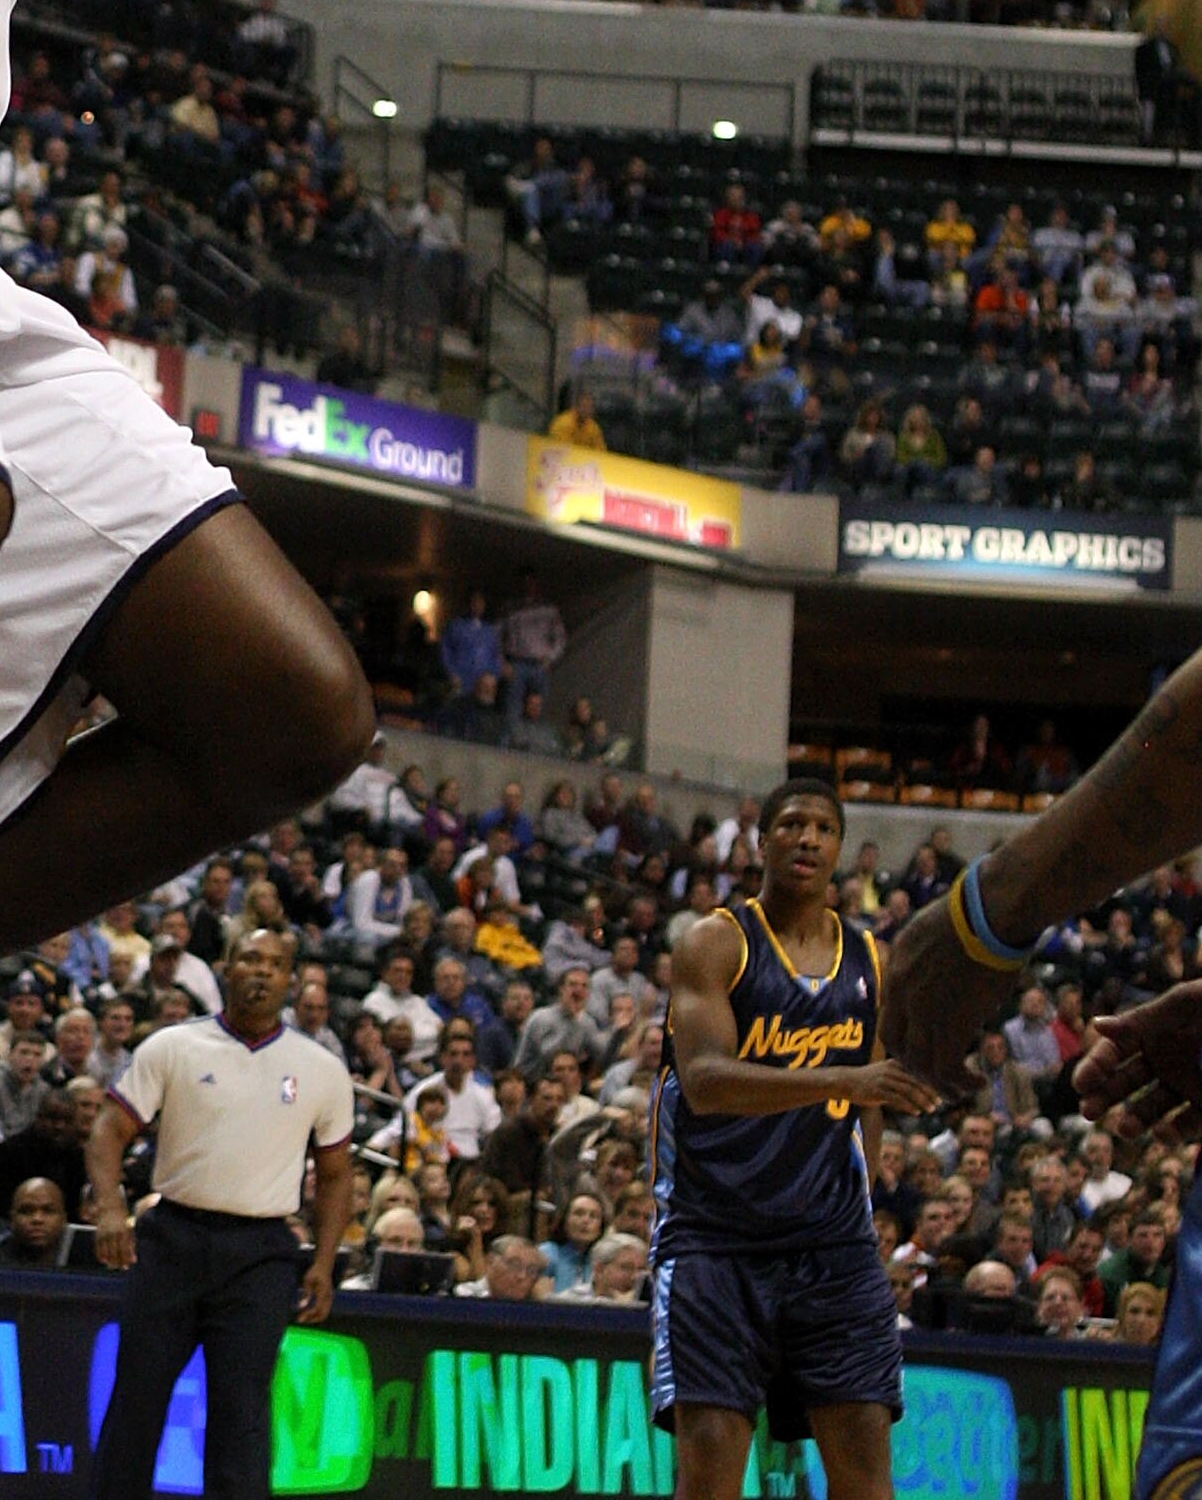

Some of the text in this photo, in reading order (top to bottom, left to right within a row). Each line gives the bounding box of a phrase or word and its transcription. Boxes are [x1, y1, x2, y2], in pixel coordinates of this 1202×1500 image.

[253, 381, 369, 460] FedEx
[369, 427, 464, 485] Ground
[843, 519, 1166, 573] SPORT GRAPHICS
[738, 1014, 864, 1071] Nuggets
[428, 1348, 762, 1498] INDIA
